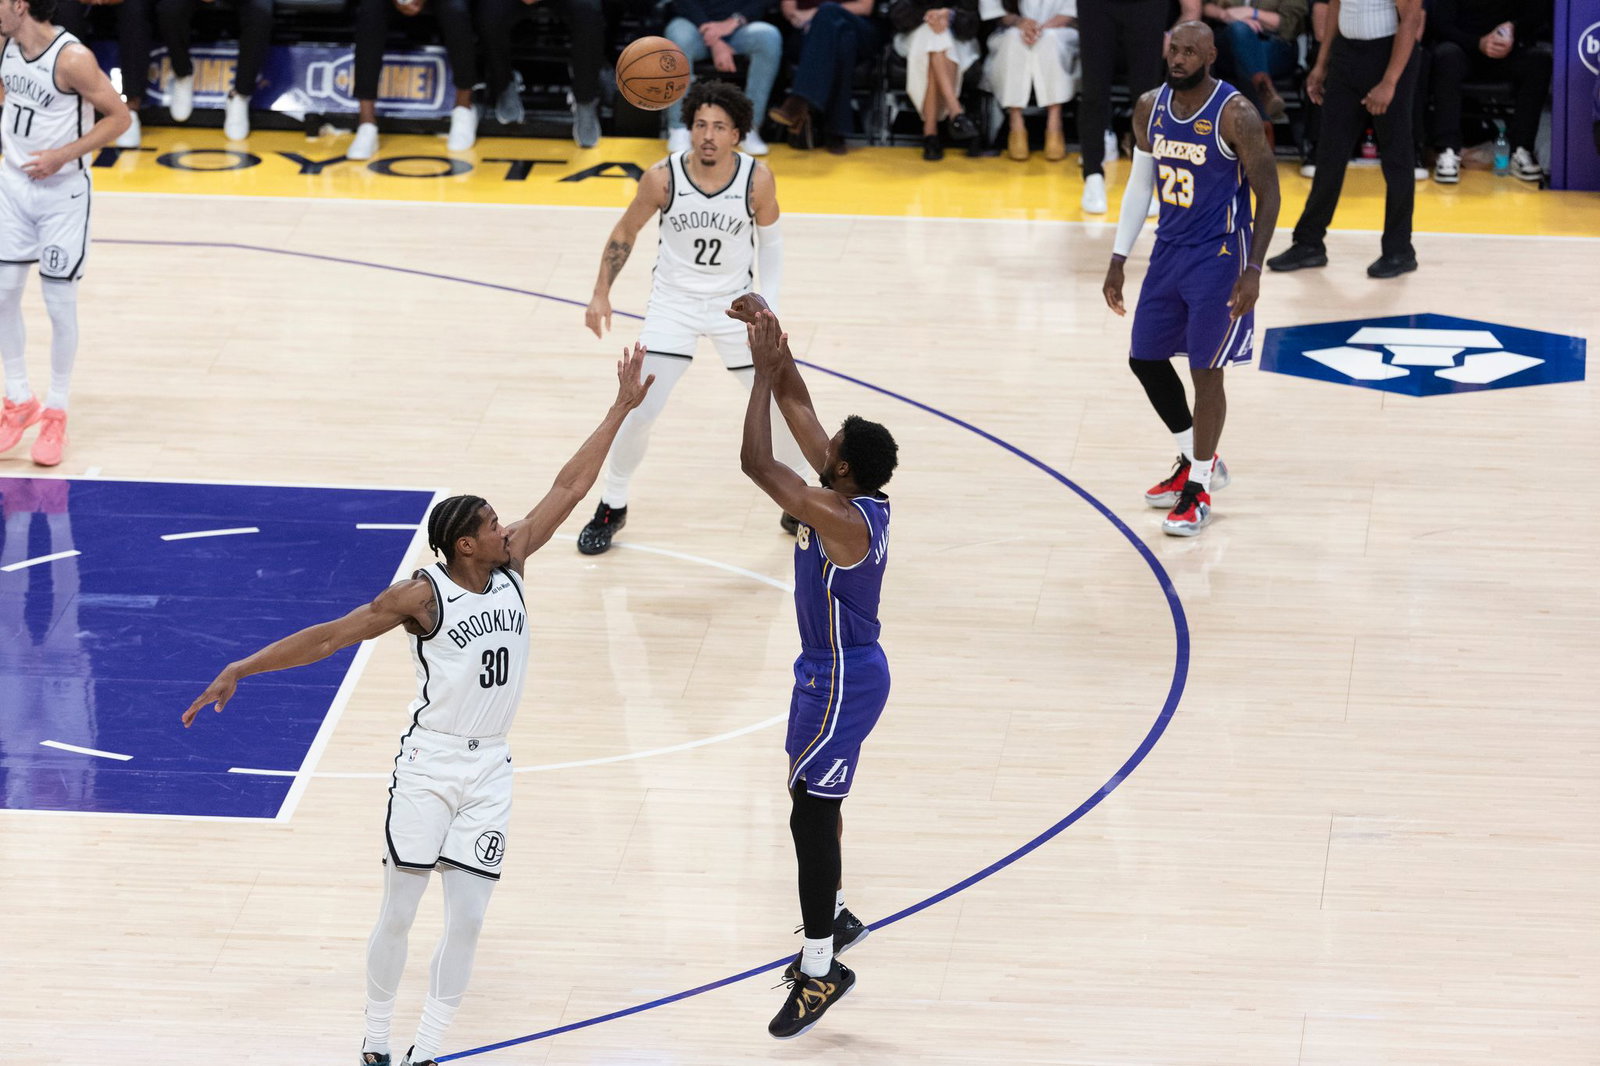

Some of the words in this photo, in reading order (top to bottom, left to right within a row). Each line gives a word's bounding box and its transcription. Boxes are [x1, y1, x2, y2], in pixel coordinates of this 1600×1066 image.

[4, 74, 55, 108] ROOKLYN
[13, 103, 35, 137] 77
[91, 147, 646, 182] TOYOTA
[1152, 133, 1207, 166] LAKERS
[1158, 164, 1195, 209] 23
[669, 211, 745, 236] BROOKLYN
[694, 238, 722, 266] 22
[447, 608, 525, 649] BROOKLYN
[479, 647, 509, 689] 30
[813, 758, 849, 788] LA
